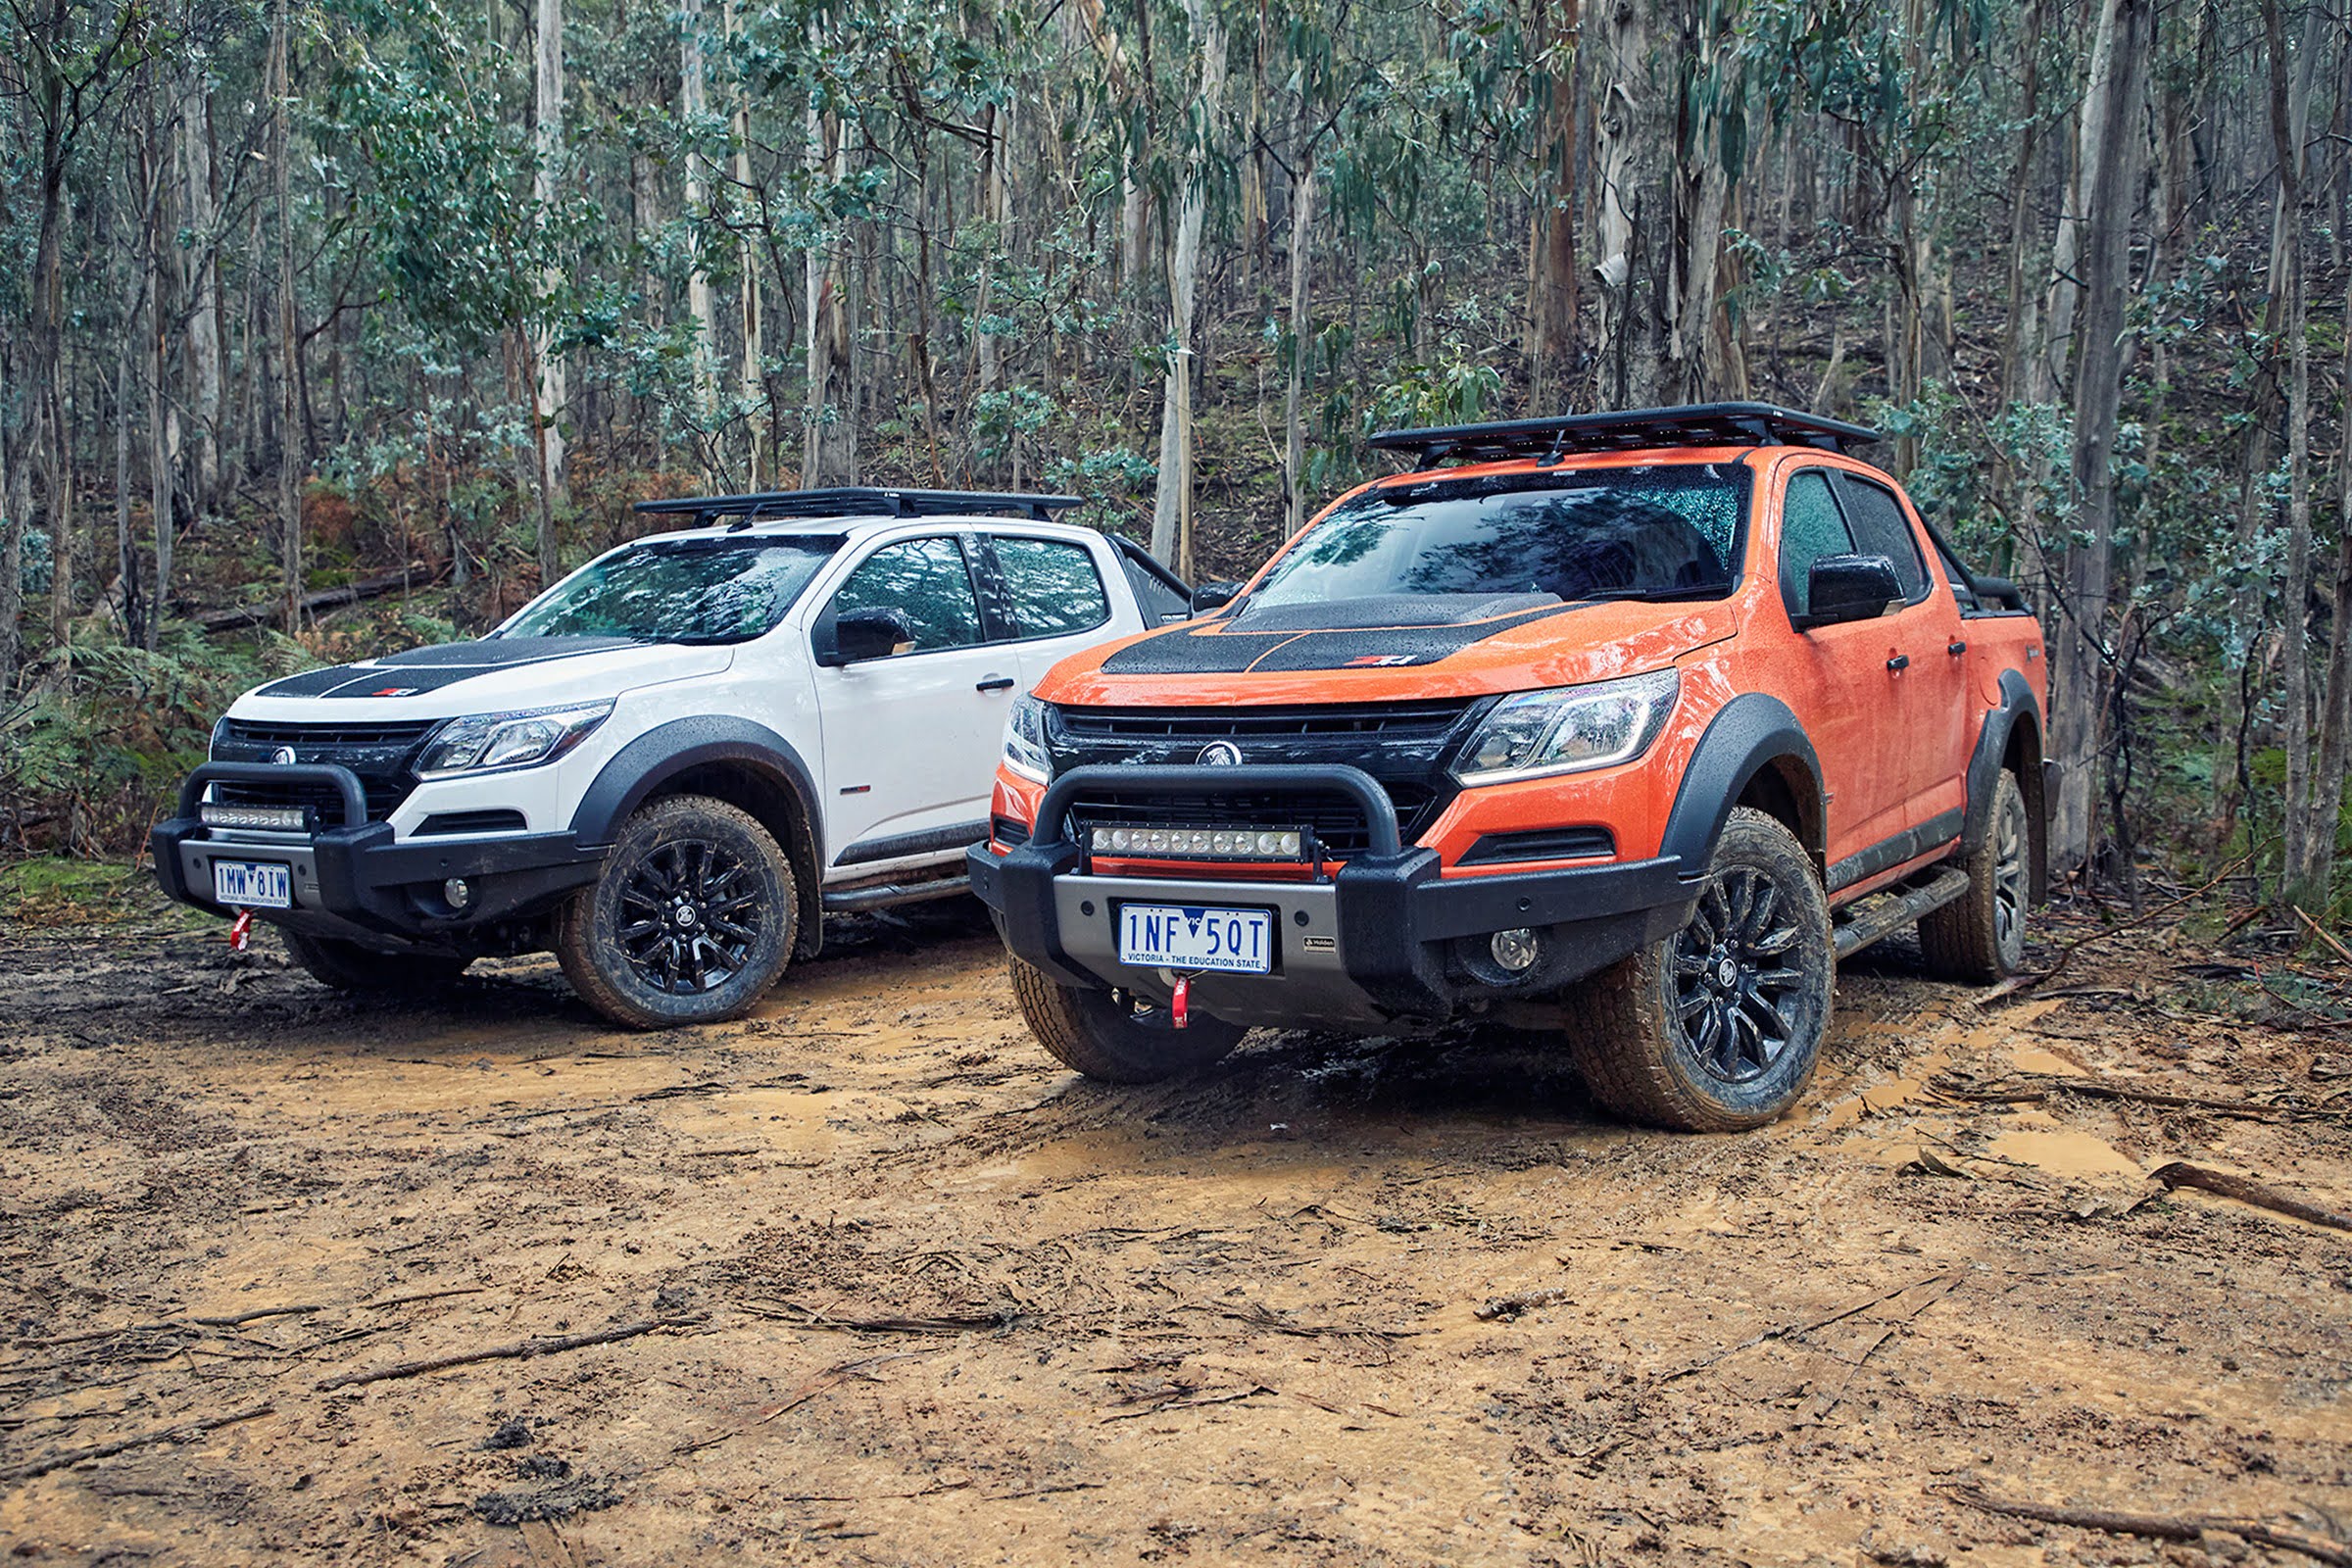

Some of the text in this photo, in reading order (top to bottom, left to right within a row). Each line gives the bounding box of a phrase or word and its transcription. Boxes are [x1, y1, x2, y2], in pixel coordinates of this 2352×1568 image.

[219, 867, 246, 895] 1MW
[1185, 916, 1201, 925] VIC
[1130, 914, 1263, 957] 1NF 5QT
[1127, 953, 1164, 962] VICTORIA
[1171, 955, 1187, 964] THE
[1189, 956, 1235, 967] EDUCATION
[1236, 958, 1260, 969] STATE
